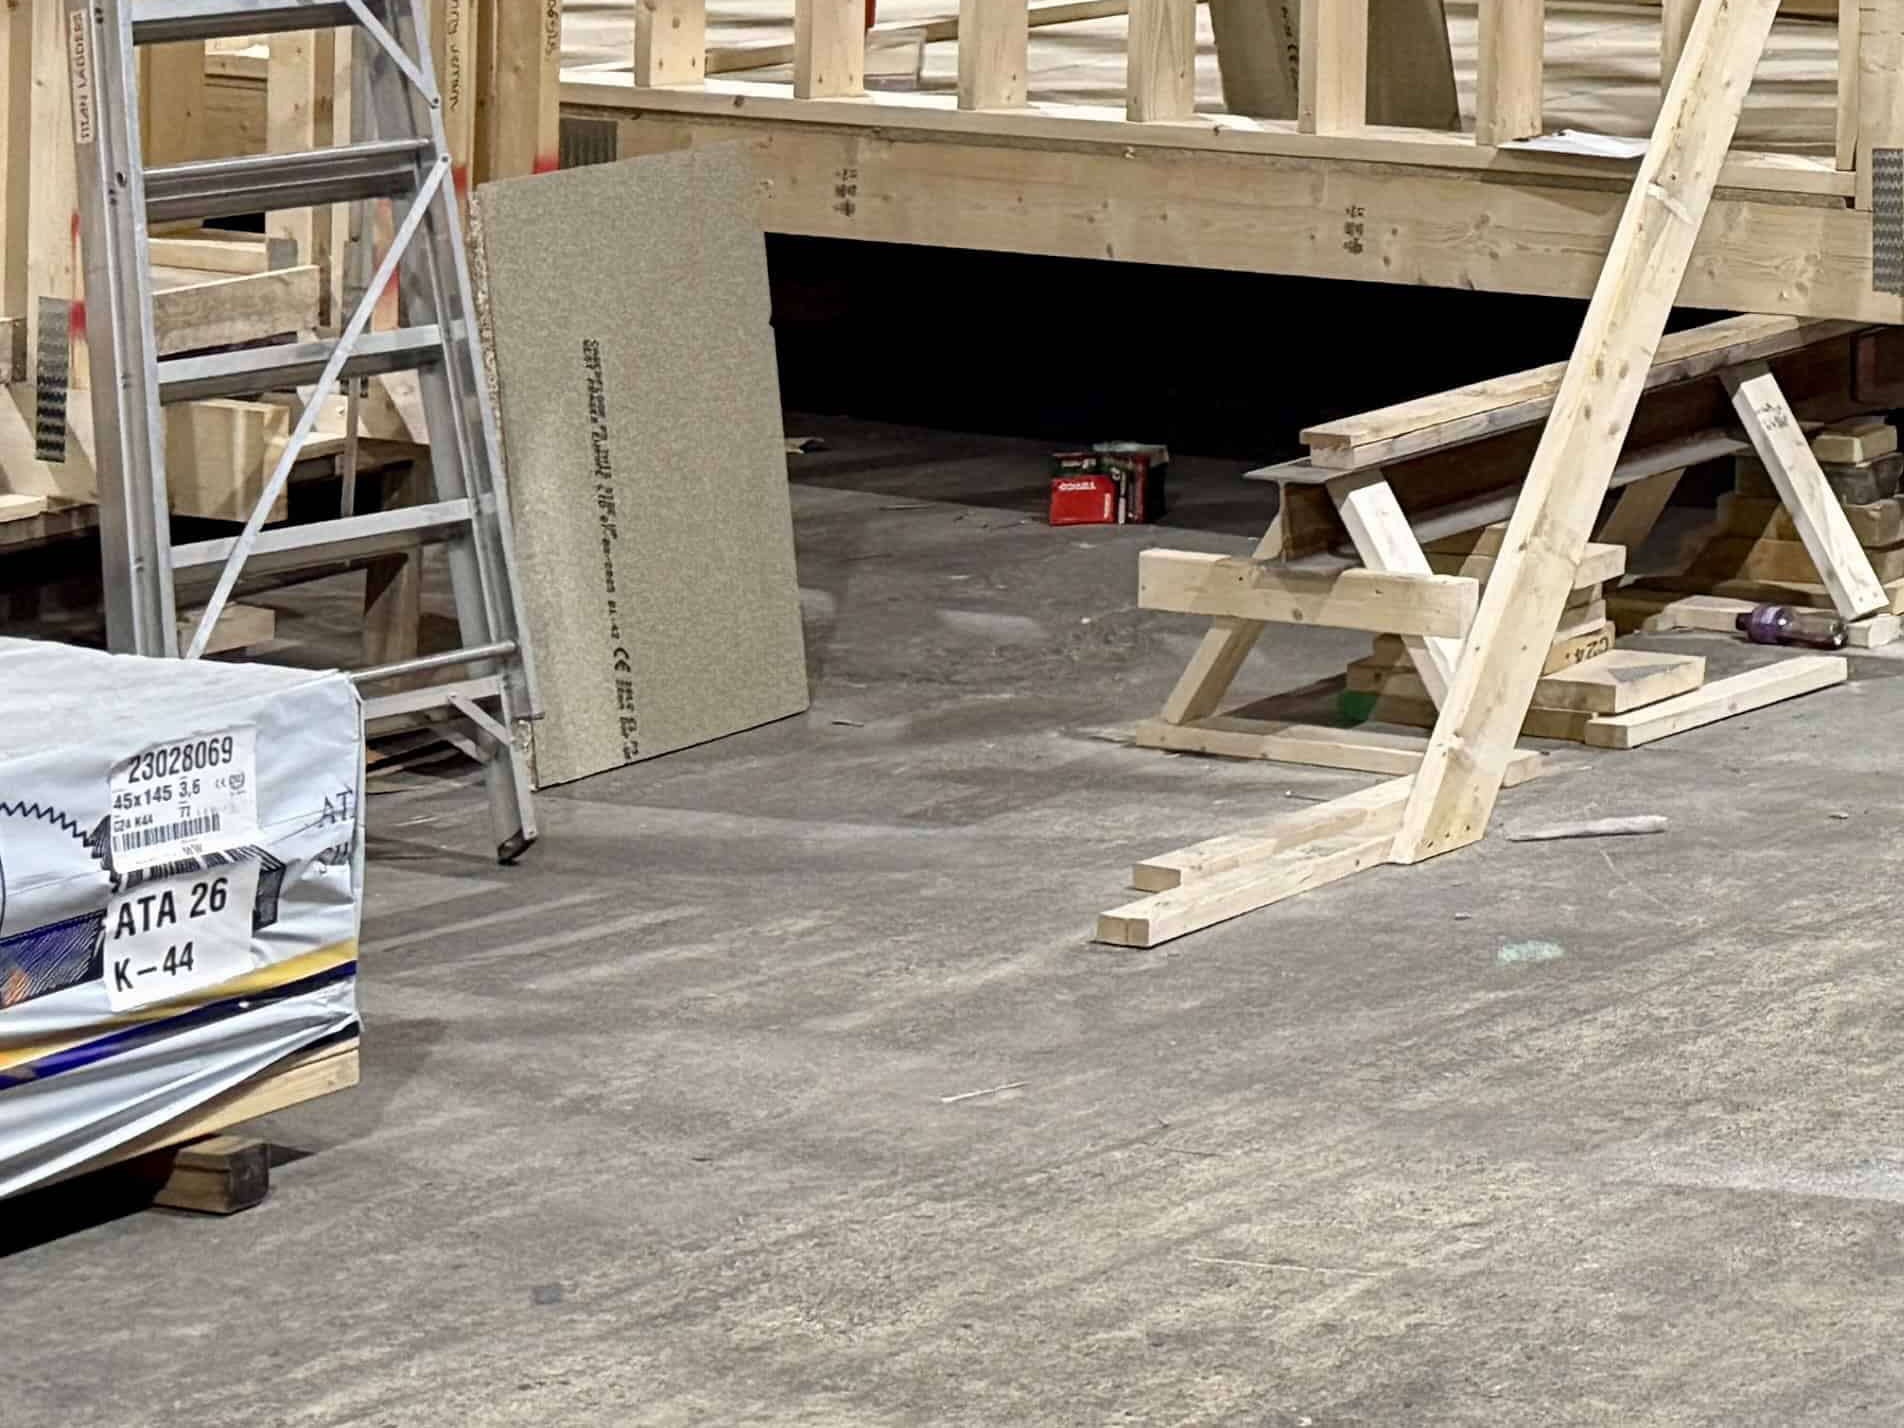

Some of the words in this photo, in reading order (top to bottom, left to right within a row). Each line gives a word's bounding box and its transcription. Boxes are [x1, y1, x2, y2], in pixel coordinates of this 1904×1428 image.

[72, 13, 87, 88] LADDERS
[128, 736, 233, 784] 23028069
[113, 890, 177, 940] ATA
[189, 877, 229, 919] 26
